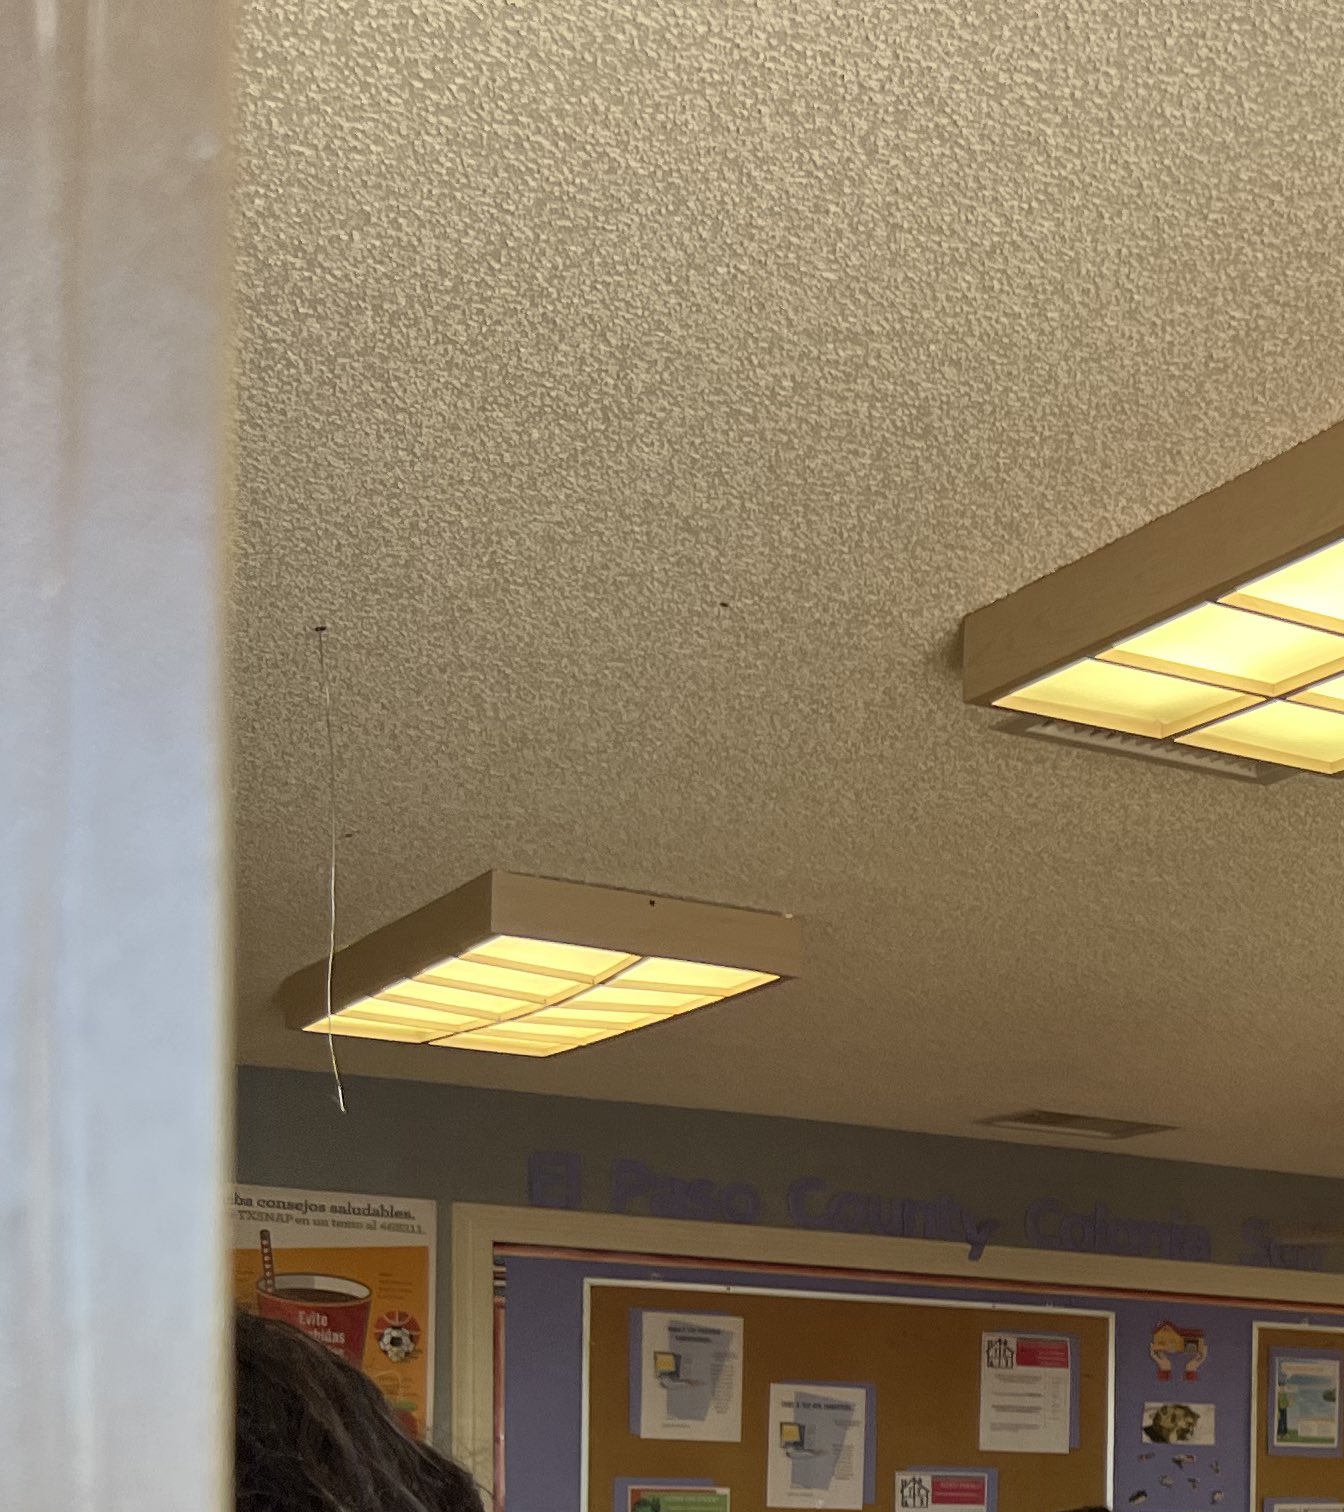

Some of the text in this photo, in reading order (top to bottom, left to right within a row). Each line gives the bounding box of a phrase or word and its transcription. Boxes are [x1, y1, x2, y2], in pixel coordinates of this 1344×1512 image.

[256, 1198, 326, 1215] consejos
[329, 1201, 416, 1220] saludables.
[528, 1152, 582, 1208] El
[612, 1157, 762, 1222] Paso
[787, 1176, 999, 1261] County
[1025, 1198, 1214, 1260] Colonia
